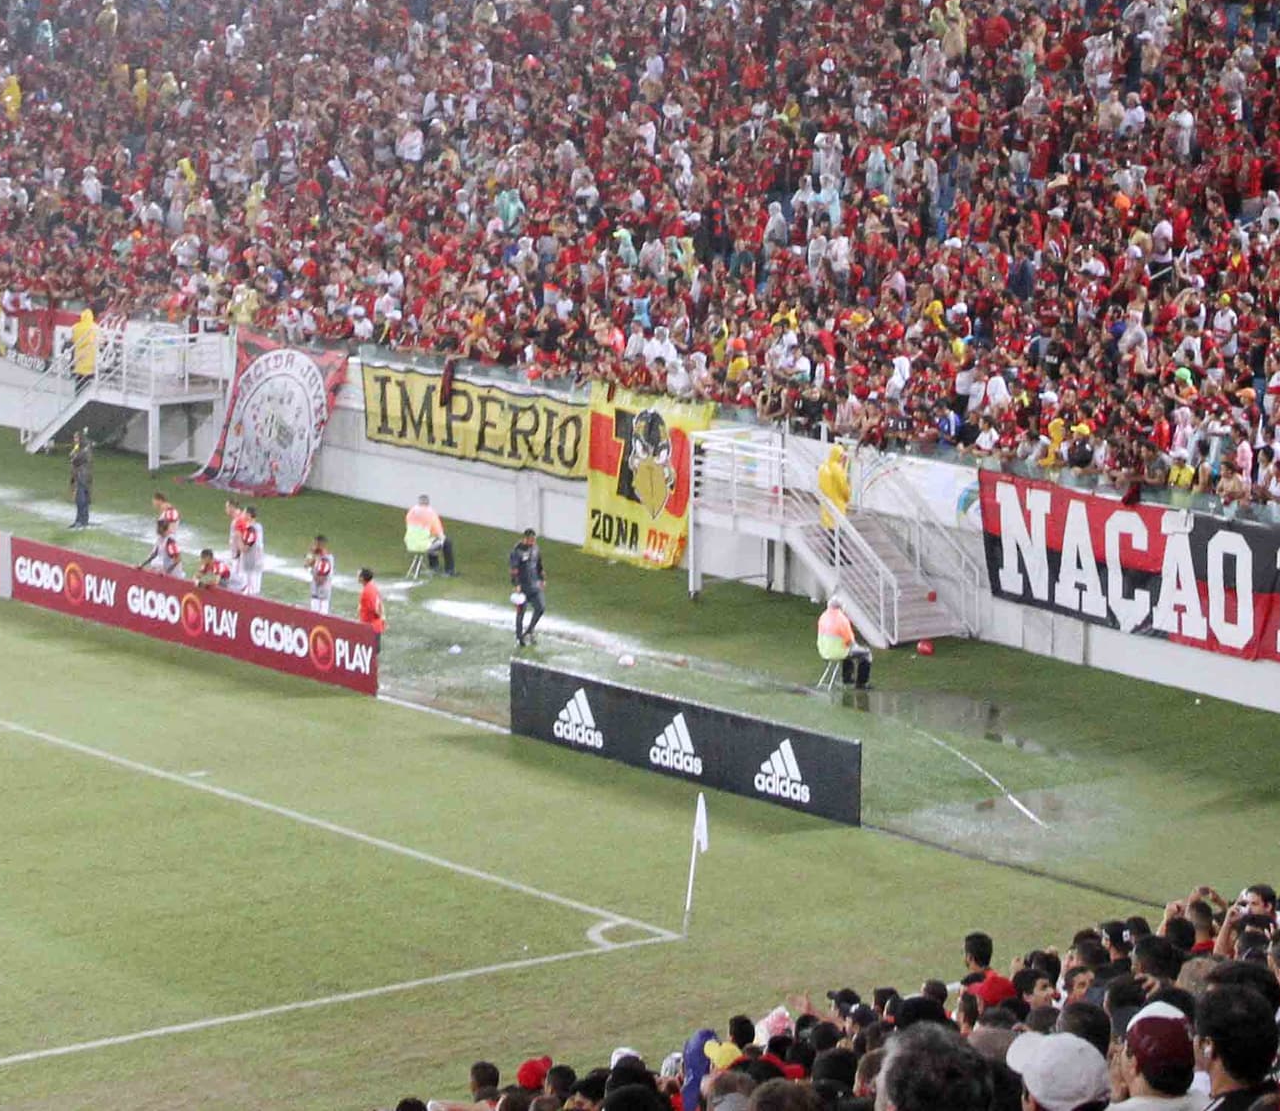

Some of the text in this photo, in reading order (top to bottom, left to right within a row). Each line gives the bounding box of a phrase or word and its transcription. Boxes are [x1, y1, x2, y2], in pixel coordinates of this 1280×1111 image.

[590, 508, 639, 550] ZONA
[15, 556, 117, 607] GLOBO PLAY
[995, 481, 1255, 649] NAÇÃO
[127, 584, 238, 639] GLOBO PLAY
[250, 616, 373, 675] GLOBO PLAY
[553, 718, 604, 749] adidas
[649, 743, 703, 776] adidas
[754, 771, 810, 803] adidas
